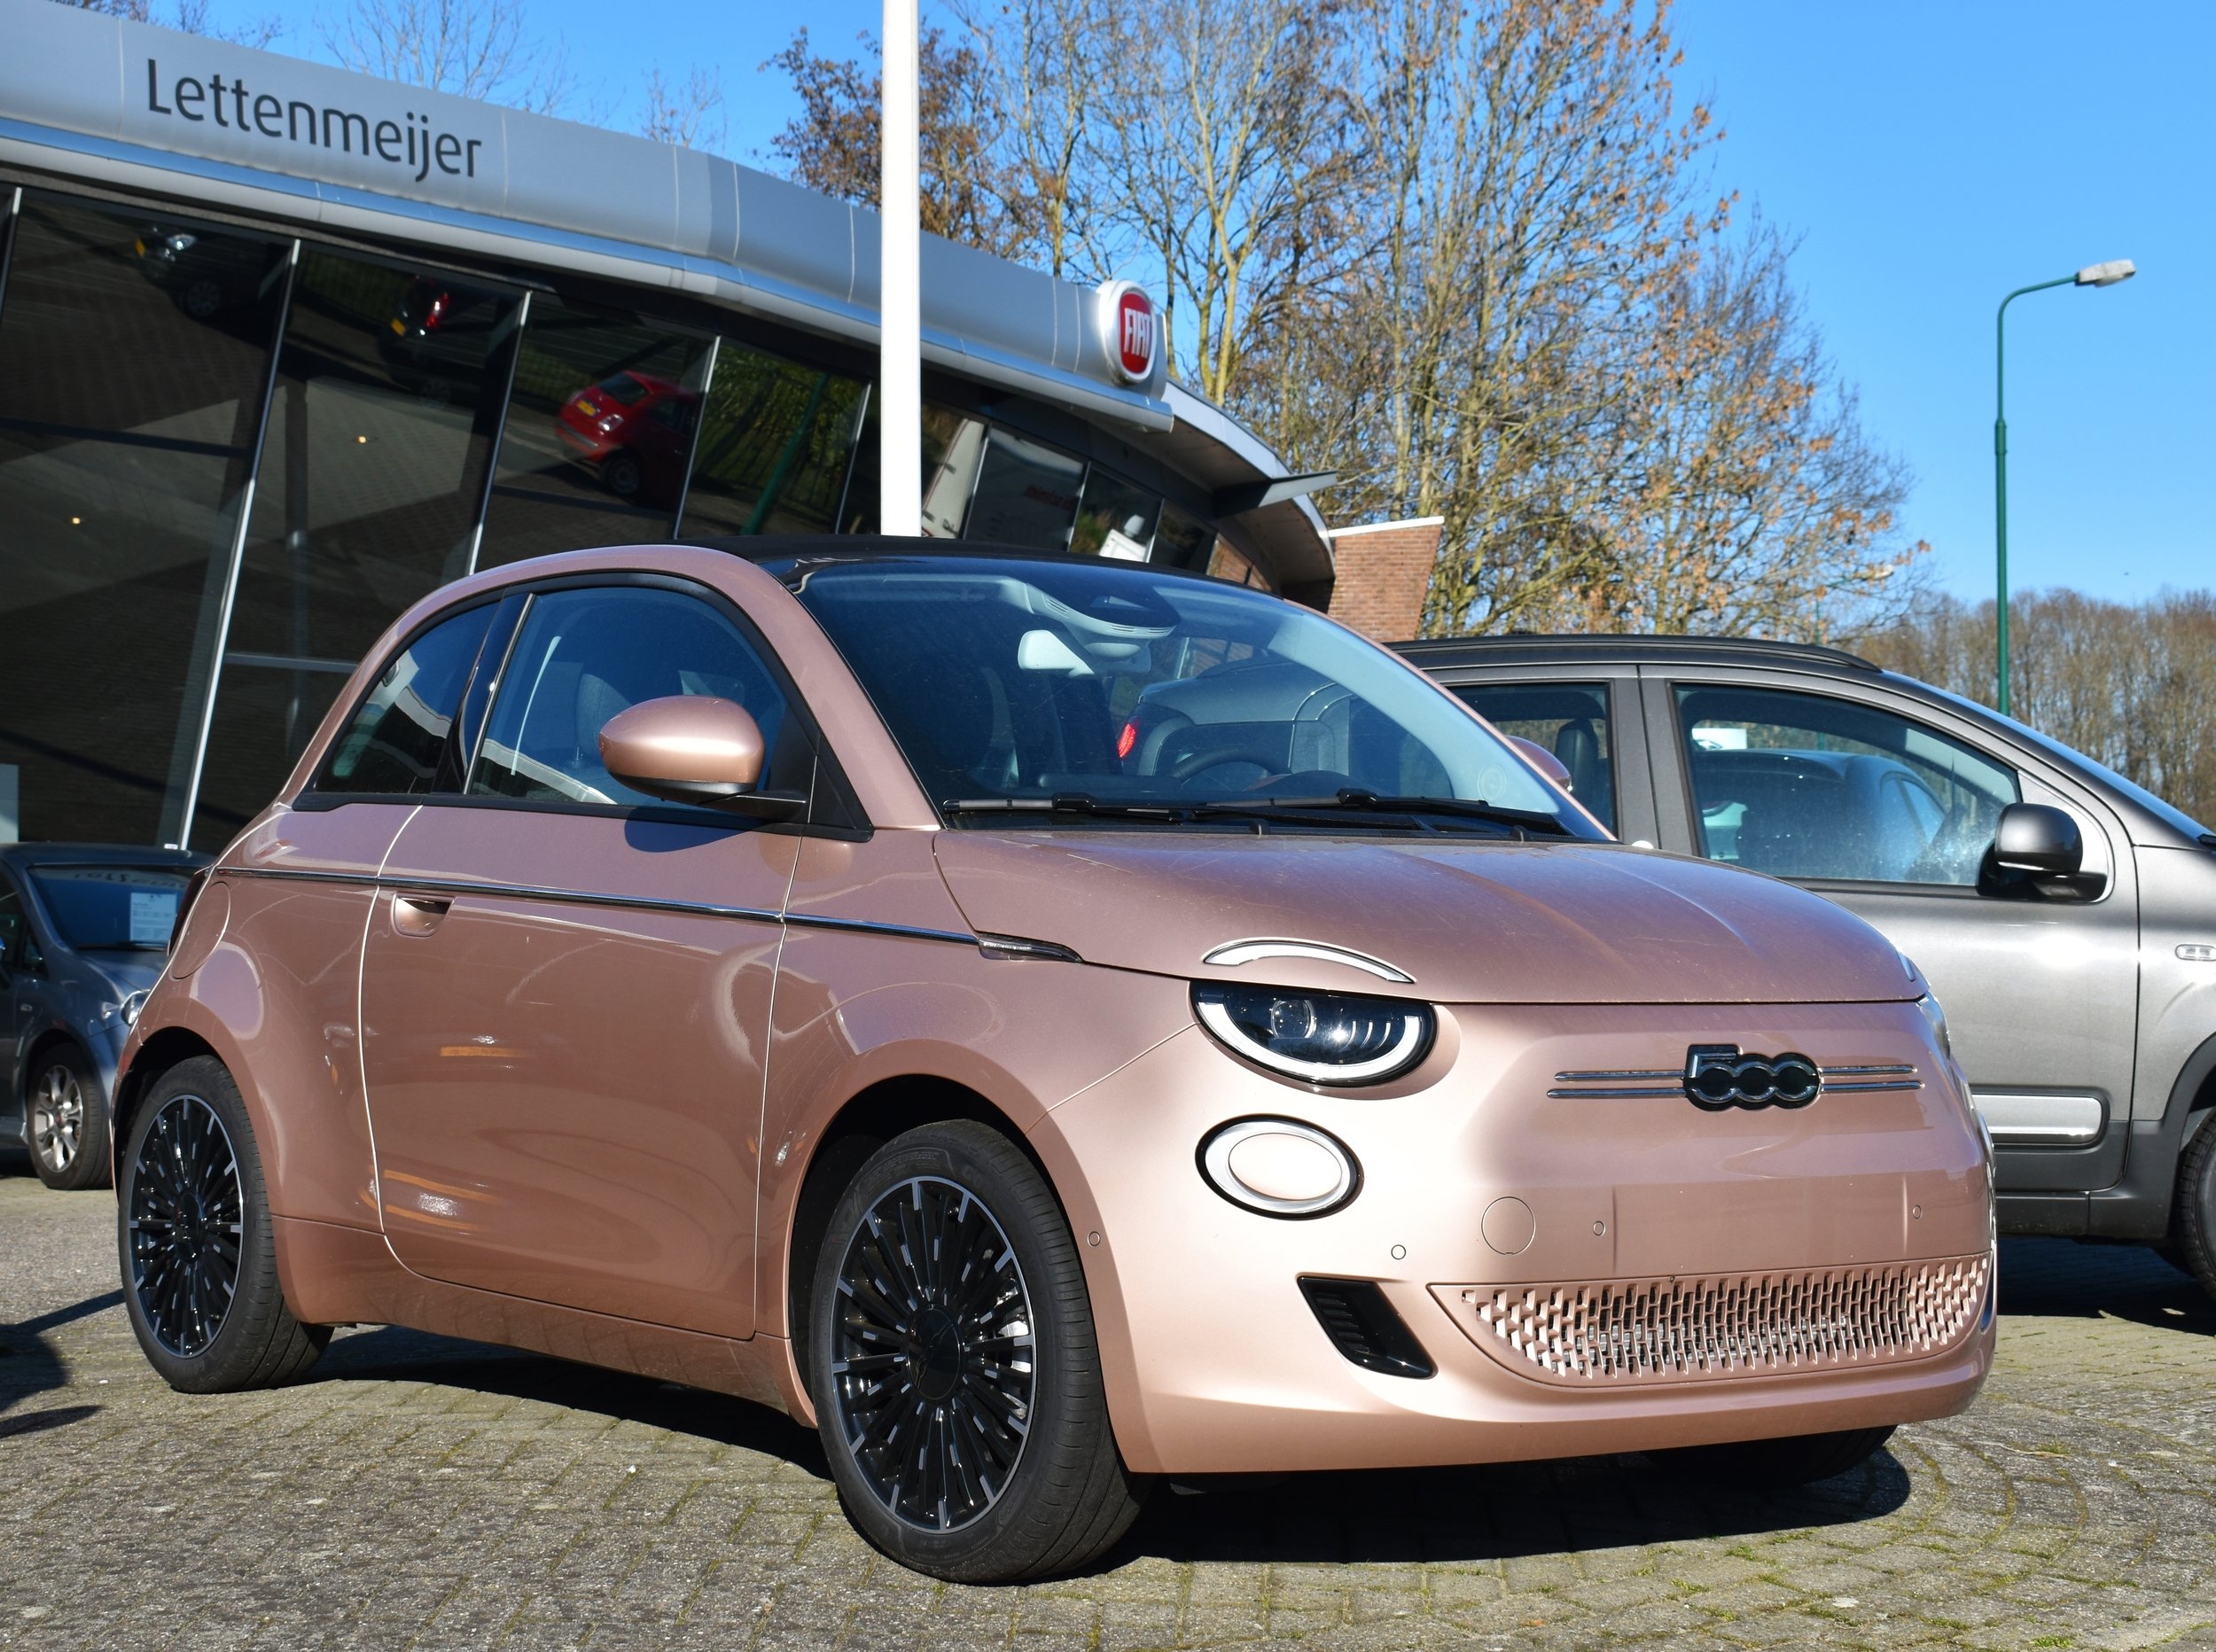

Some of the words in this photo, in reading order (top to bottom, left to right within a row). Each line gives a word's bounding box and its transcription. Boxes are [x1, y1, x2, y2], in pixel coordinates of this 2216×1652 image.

[147, 58, 482, 183] Lettenmeijer
[1123, 307, 1151, 359] FIAT
[1686, 1047, 1819, 1109] 500
